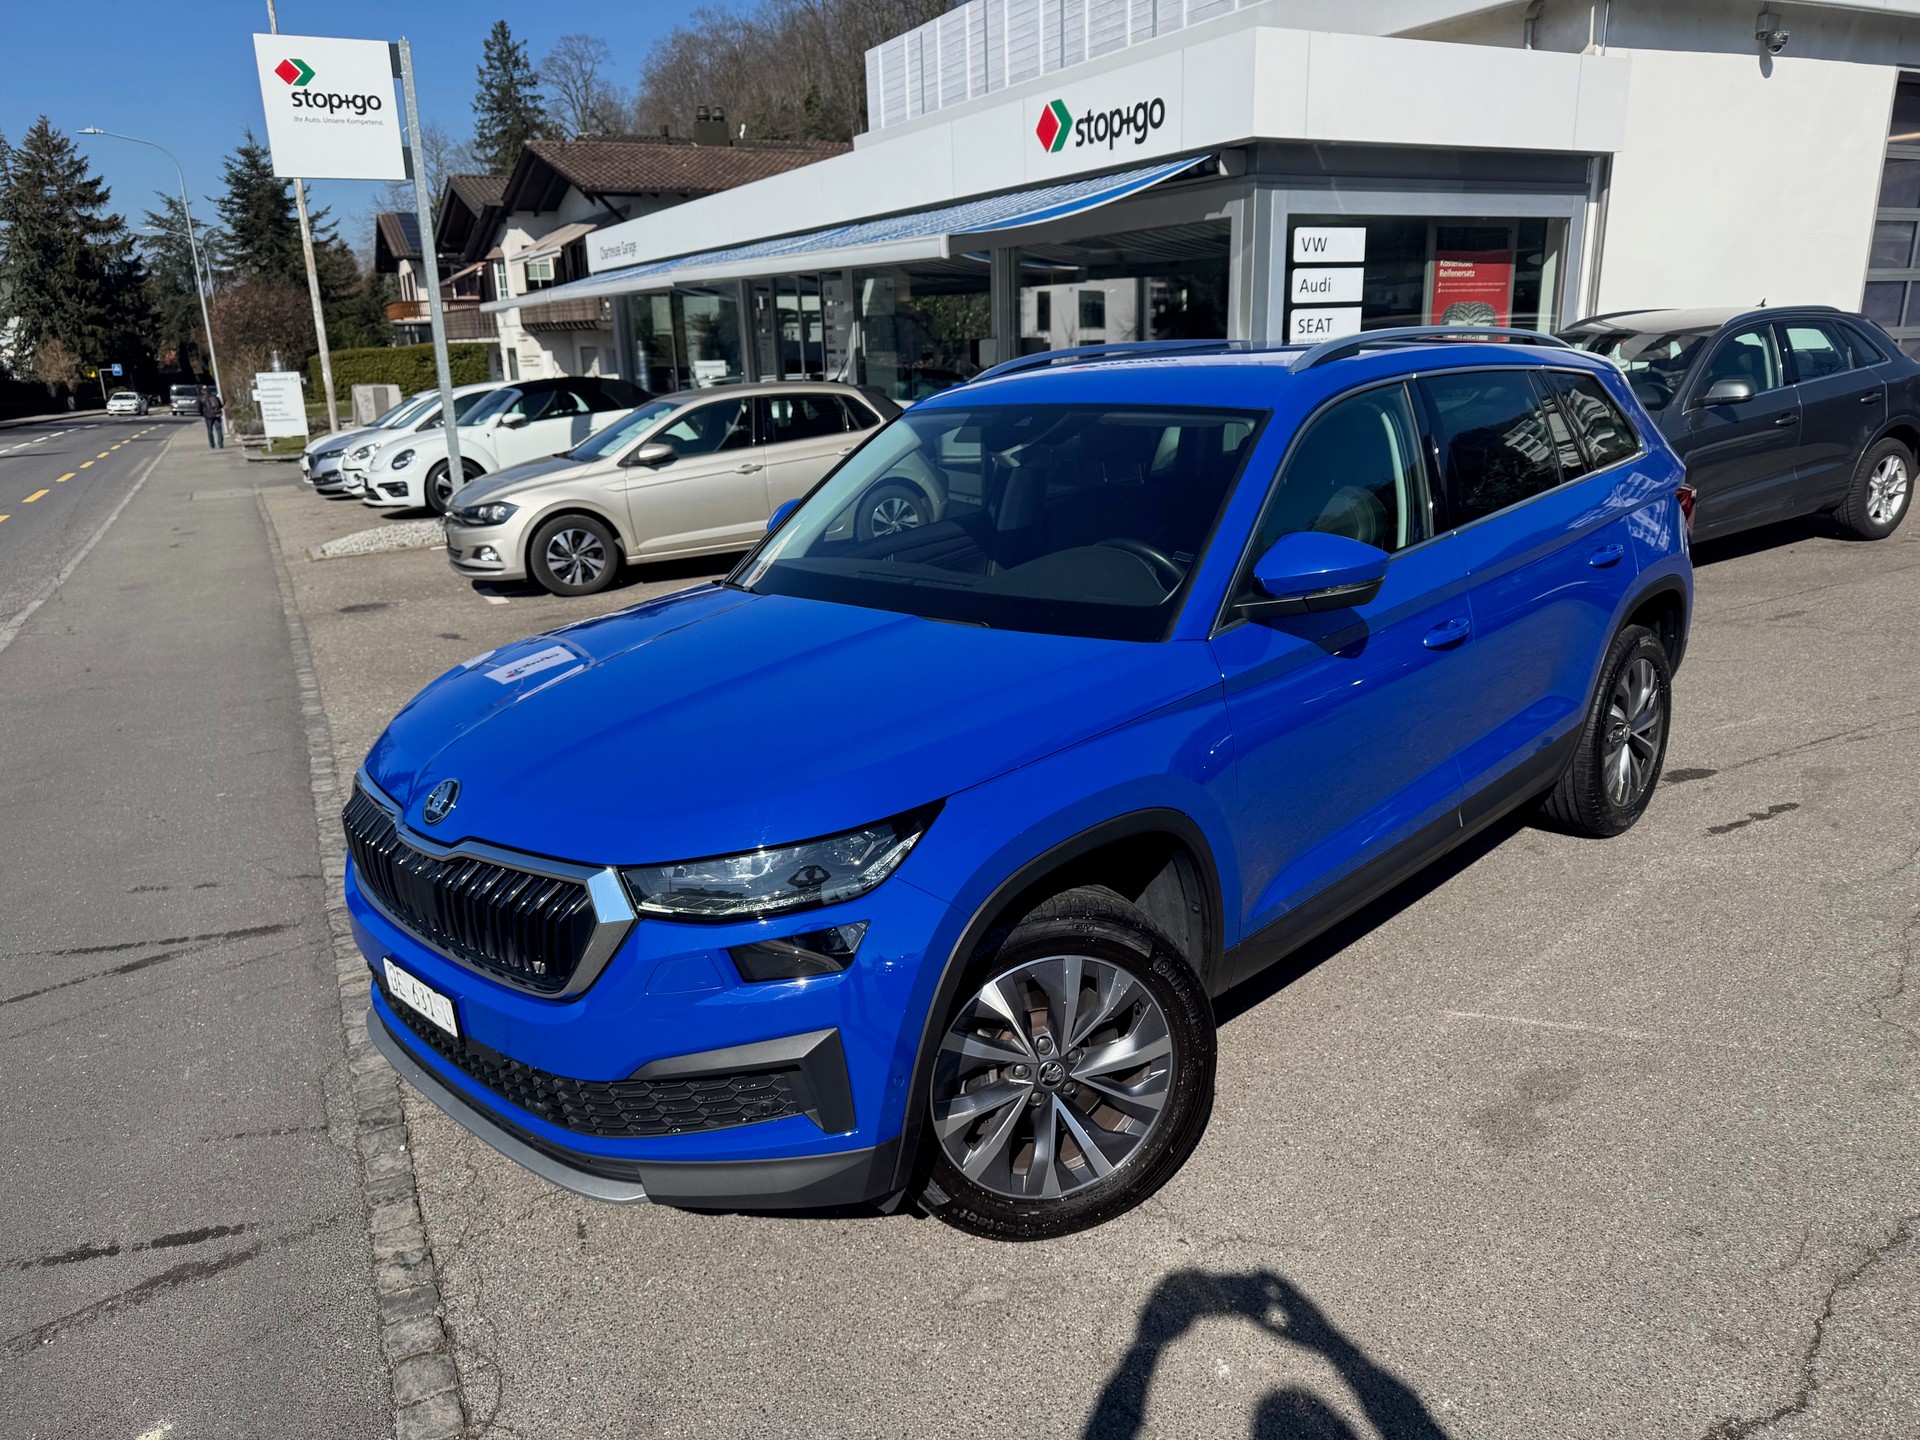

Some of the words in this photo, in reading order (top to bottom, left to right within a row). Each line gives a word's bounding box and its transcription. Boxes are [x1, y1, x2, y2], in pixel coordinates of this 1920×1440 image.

[291, 89, 382, 115] stop+go
[1075, 97, 1165, 150] stop+go
[1302, 237, 1328, 252] VW
[1299, 277, 1332, 293] Audi
[1298, 317, 1333, 334] SEAT
